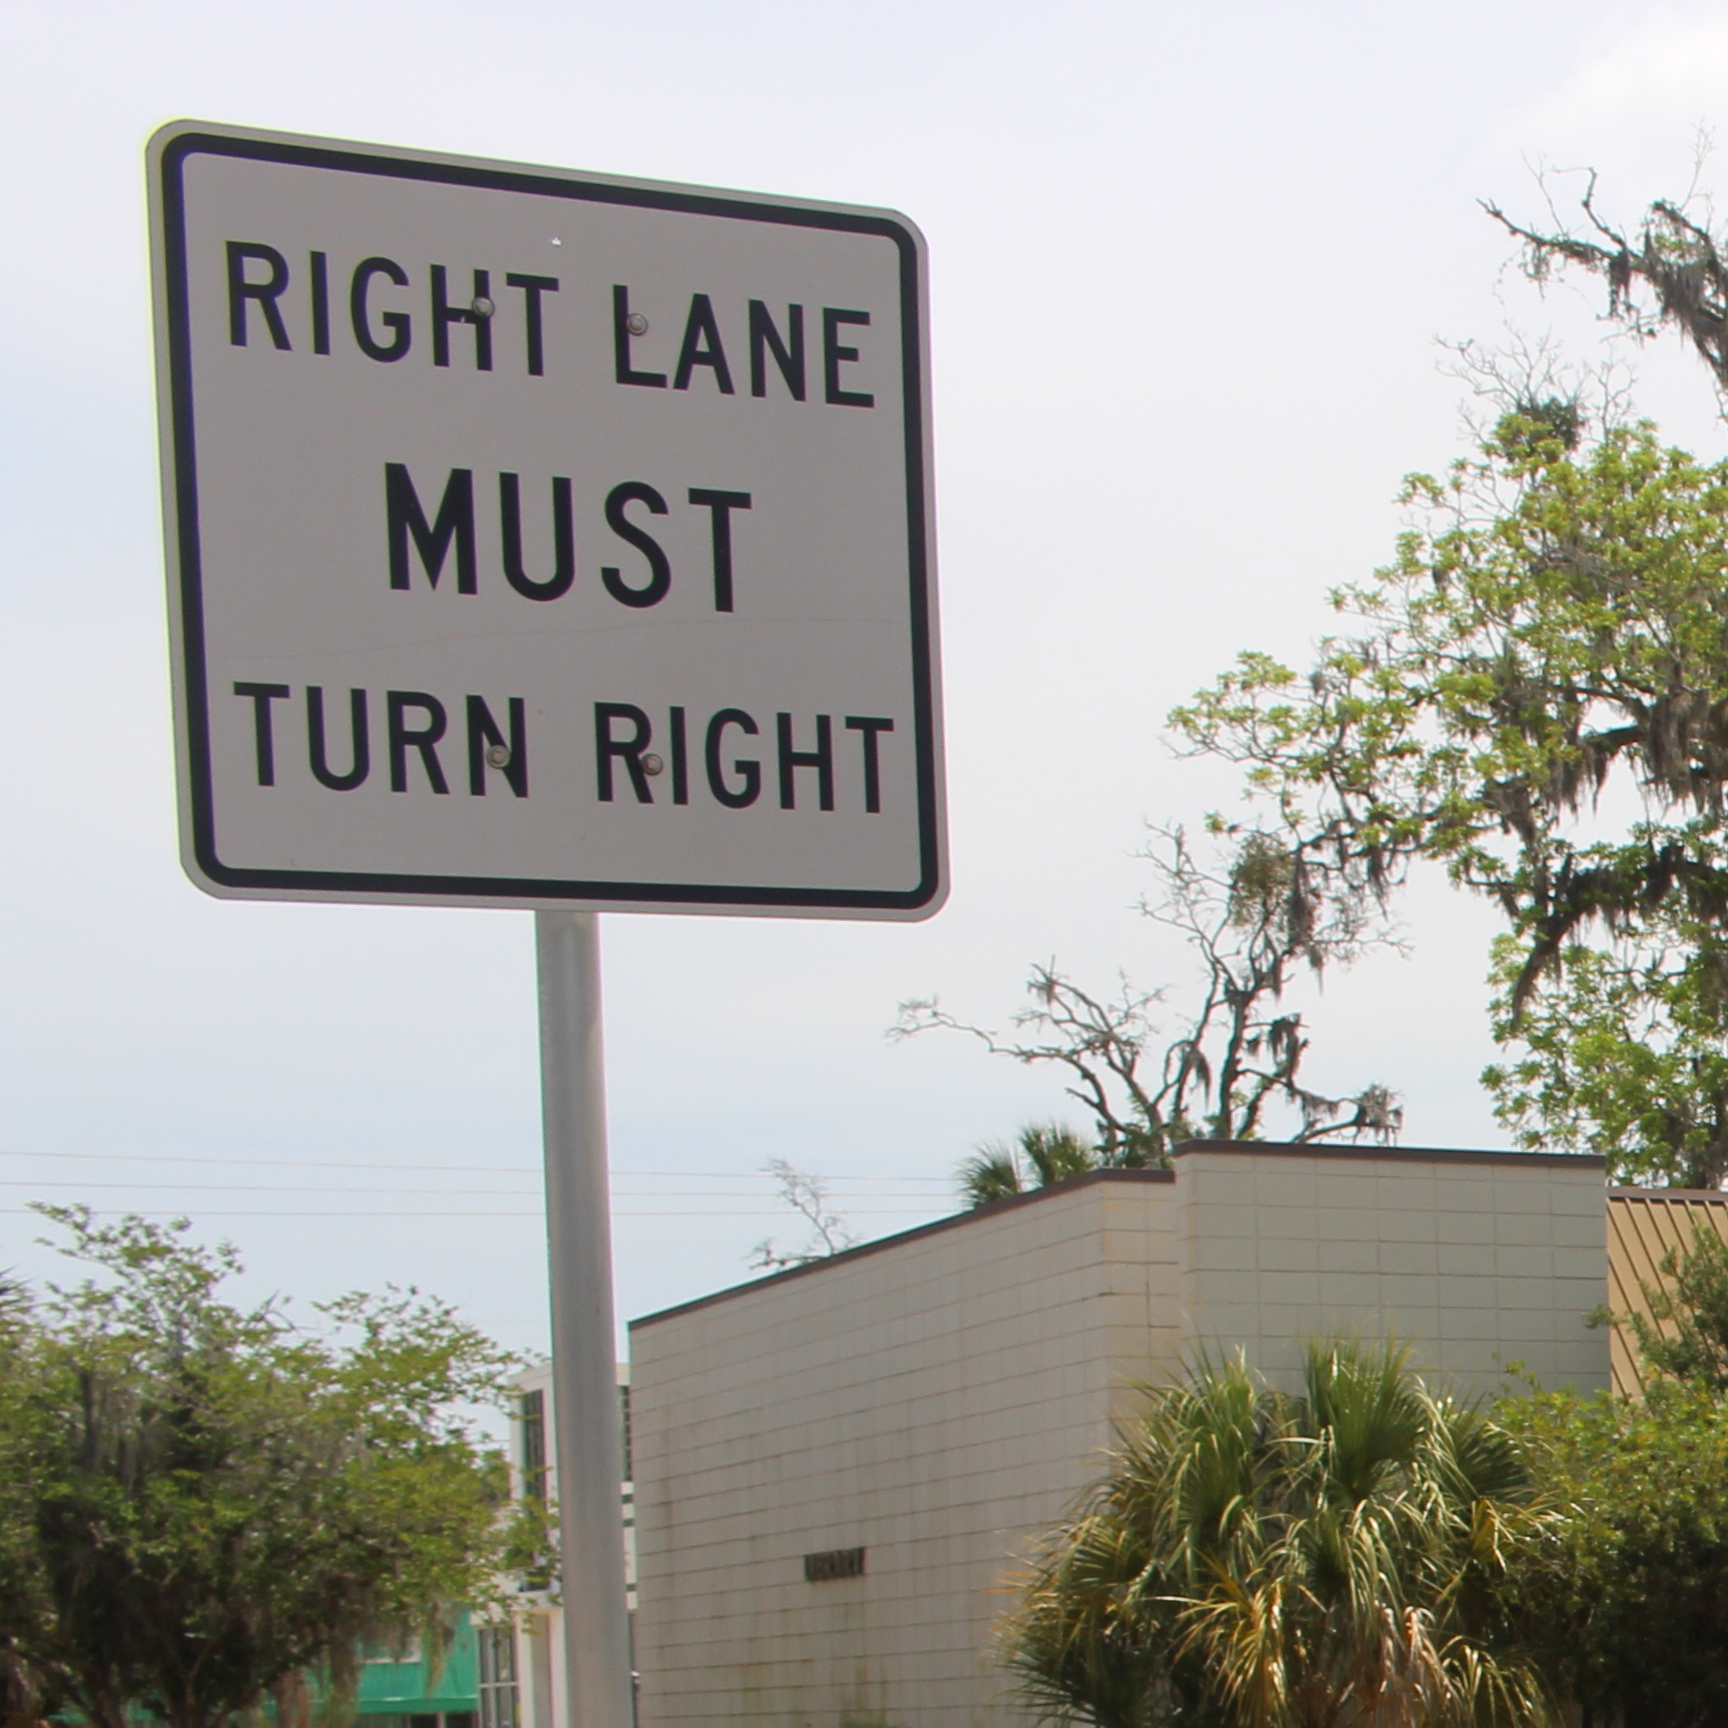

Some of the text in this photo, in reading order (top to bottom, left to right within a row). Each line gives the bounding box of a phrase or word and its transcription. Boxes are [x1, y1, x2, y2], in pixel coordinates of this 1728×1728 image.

[226, 241, 875, 408] RIGHT LANE
[385, 463, 752, 612] MUST
[234, 682, 894, 814] TURN RIGHT
